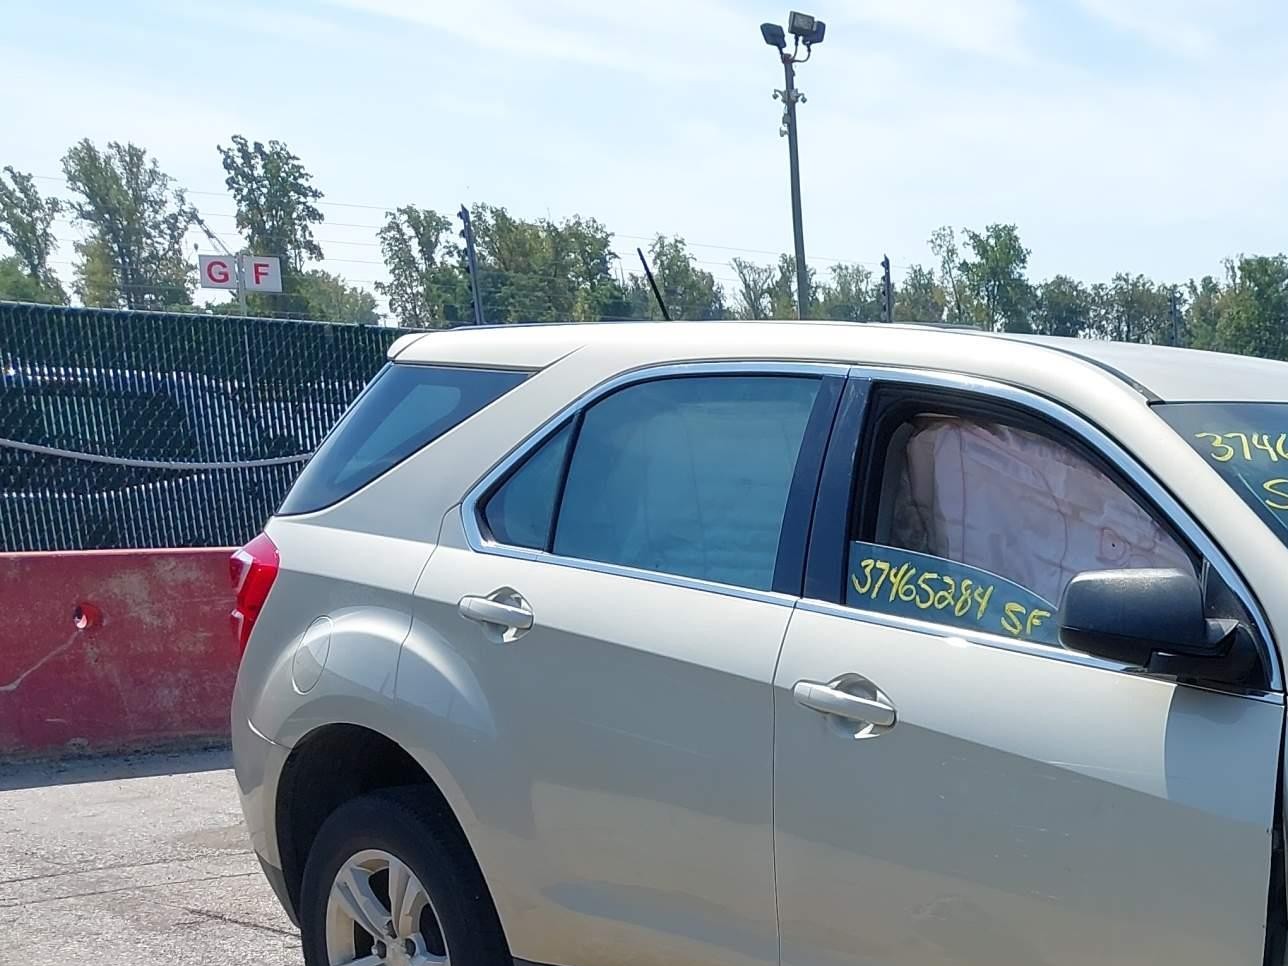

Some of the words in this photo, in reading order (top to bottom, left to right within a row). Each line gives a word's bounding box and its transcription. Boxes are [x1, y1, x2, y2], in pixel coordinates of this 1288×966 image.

[206, 261, 229, 284] G
[254, 263, 269, 285] F
[852, 559, 994, 620] 37465284
[1001, 602, 1051, 635] SF
